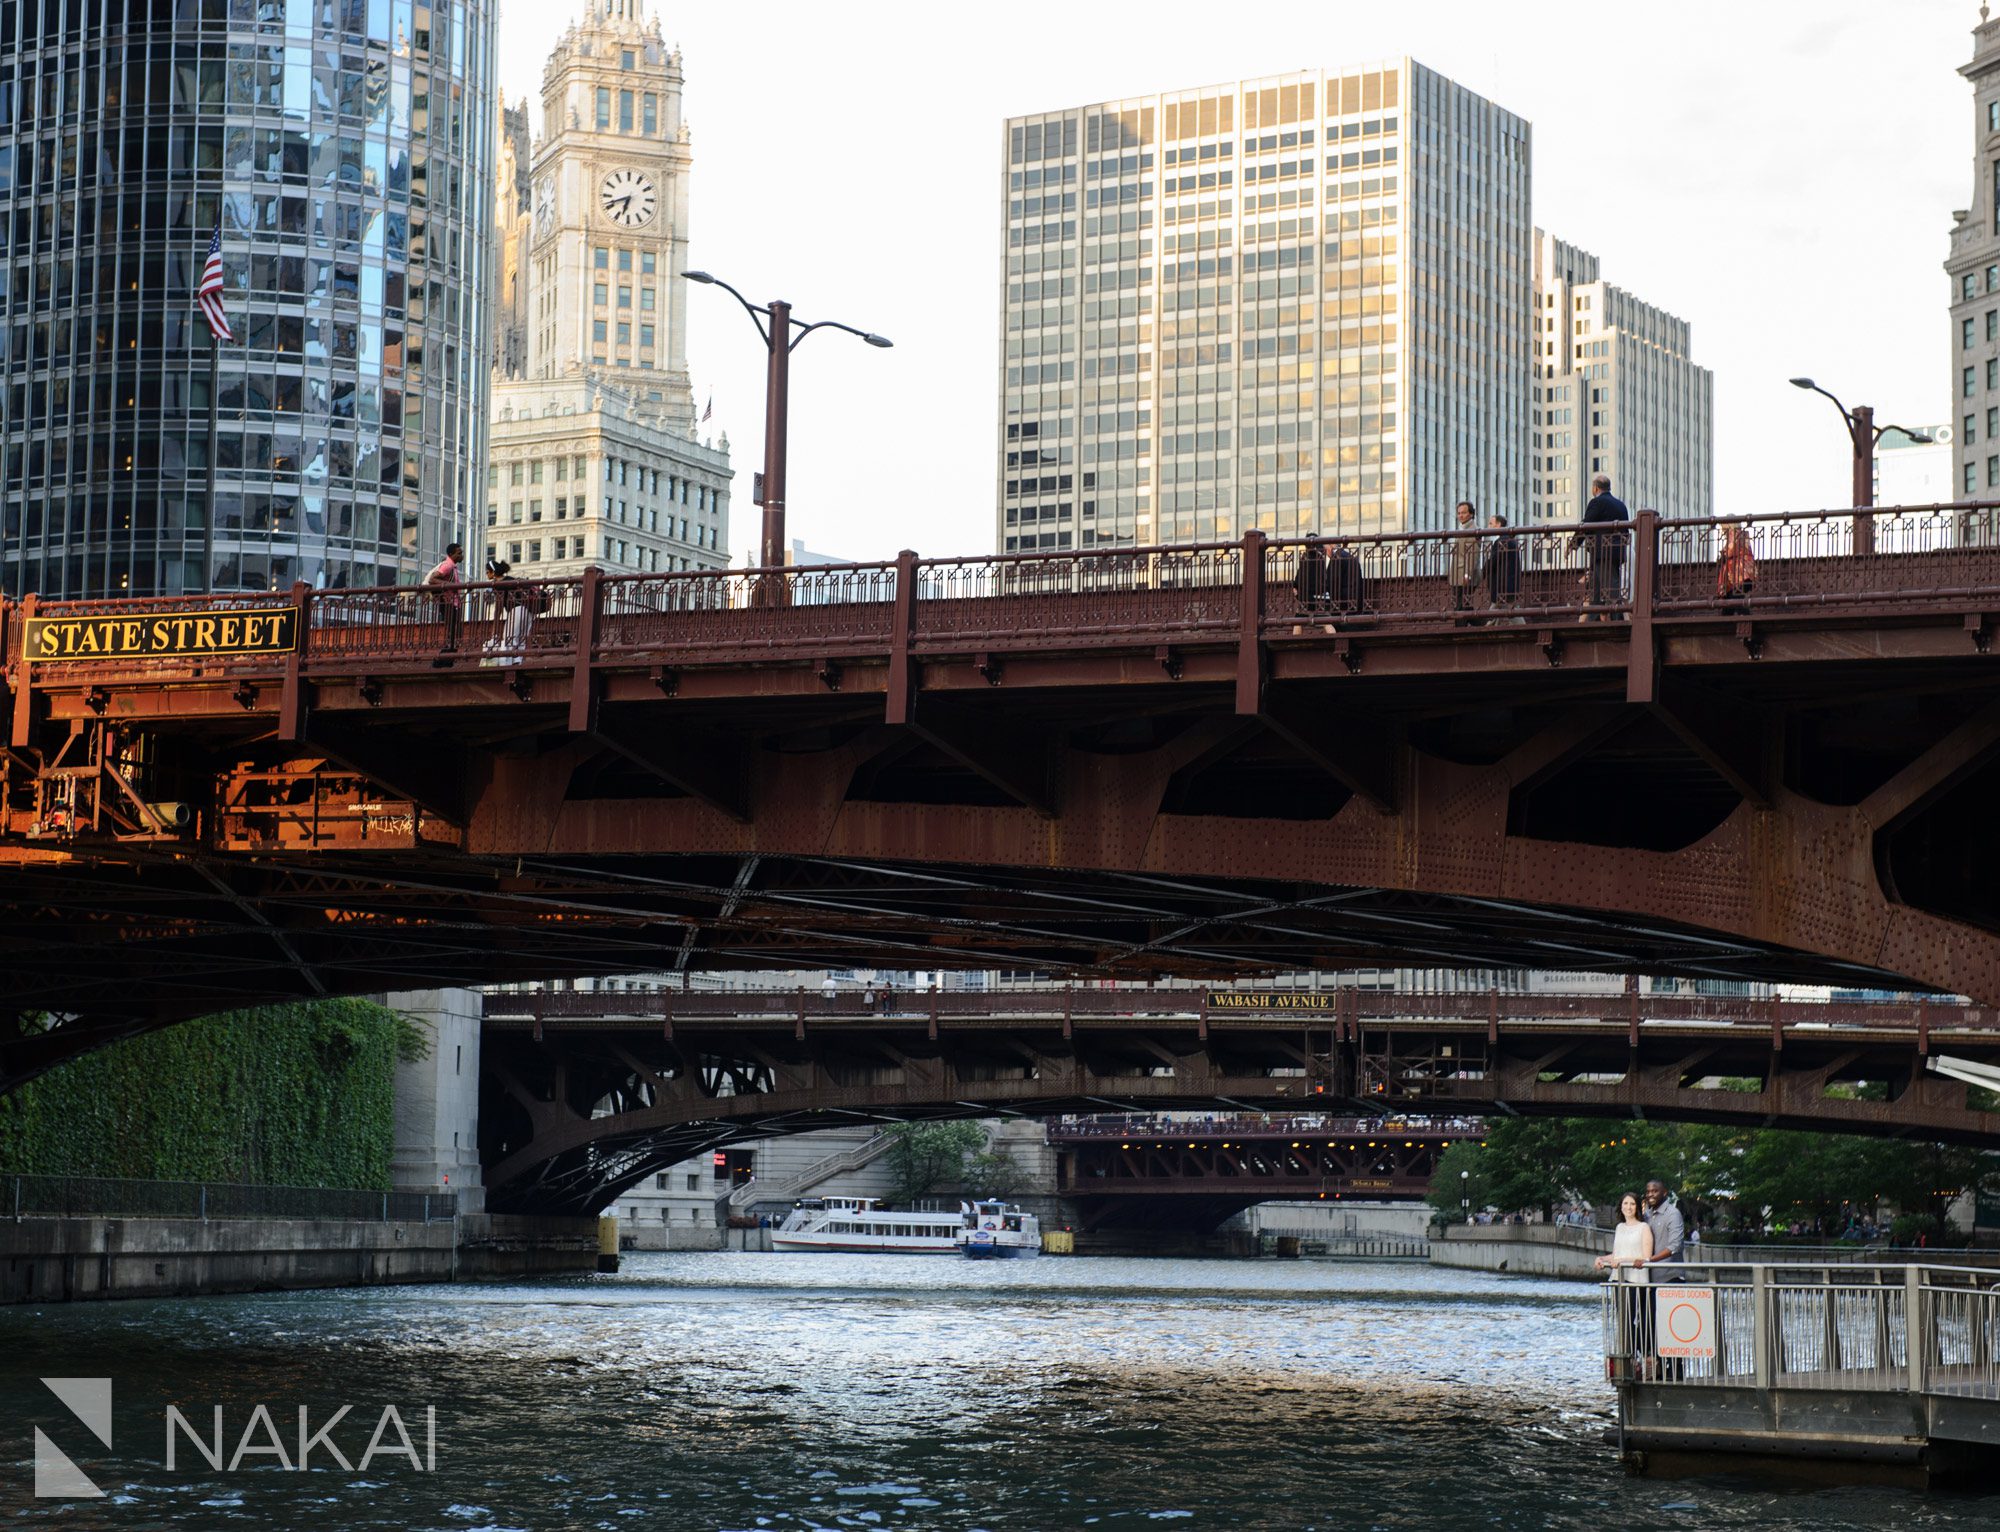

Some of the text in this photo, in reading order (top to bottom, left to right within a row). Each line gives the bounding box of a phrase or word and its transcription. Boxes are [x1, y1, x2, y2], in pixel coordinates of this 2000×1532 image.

[41, 615, 286, 654] STATE STREET
[1215, 995, 1328, 1008] WABASH AVENUE
[1658, 1290, 1712, 1299] RESERVED DOCKING
[1660, 1347, 1713, 1357] MONITOR CH 16
